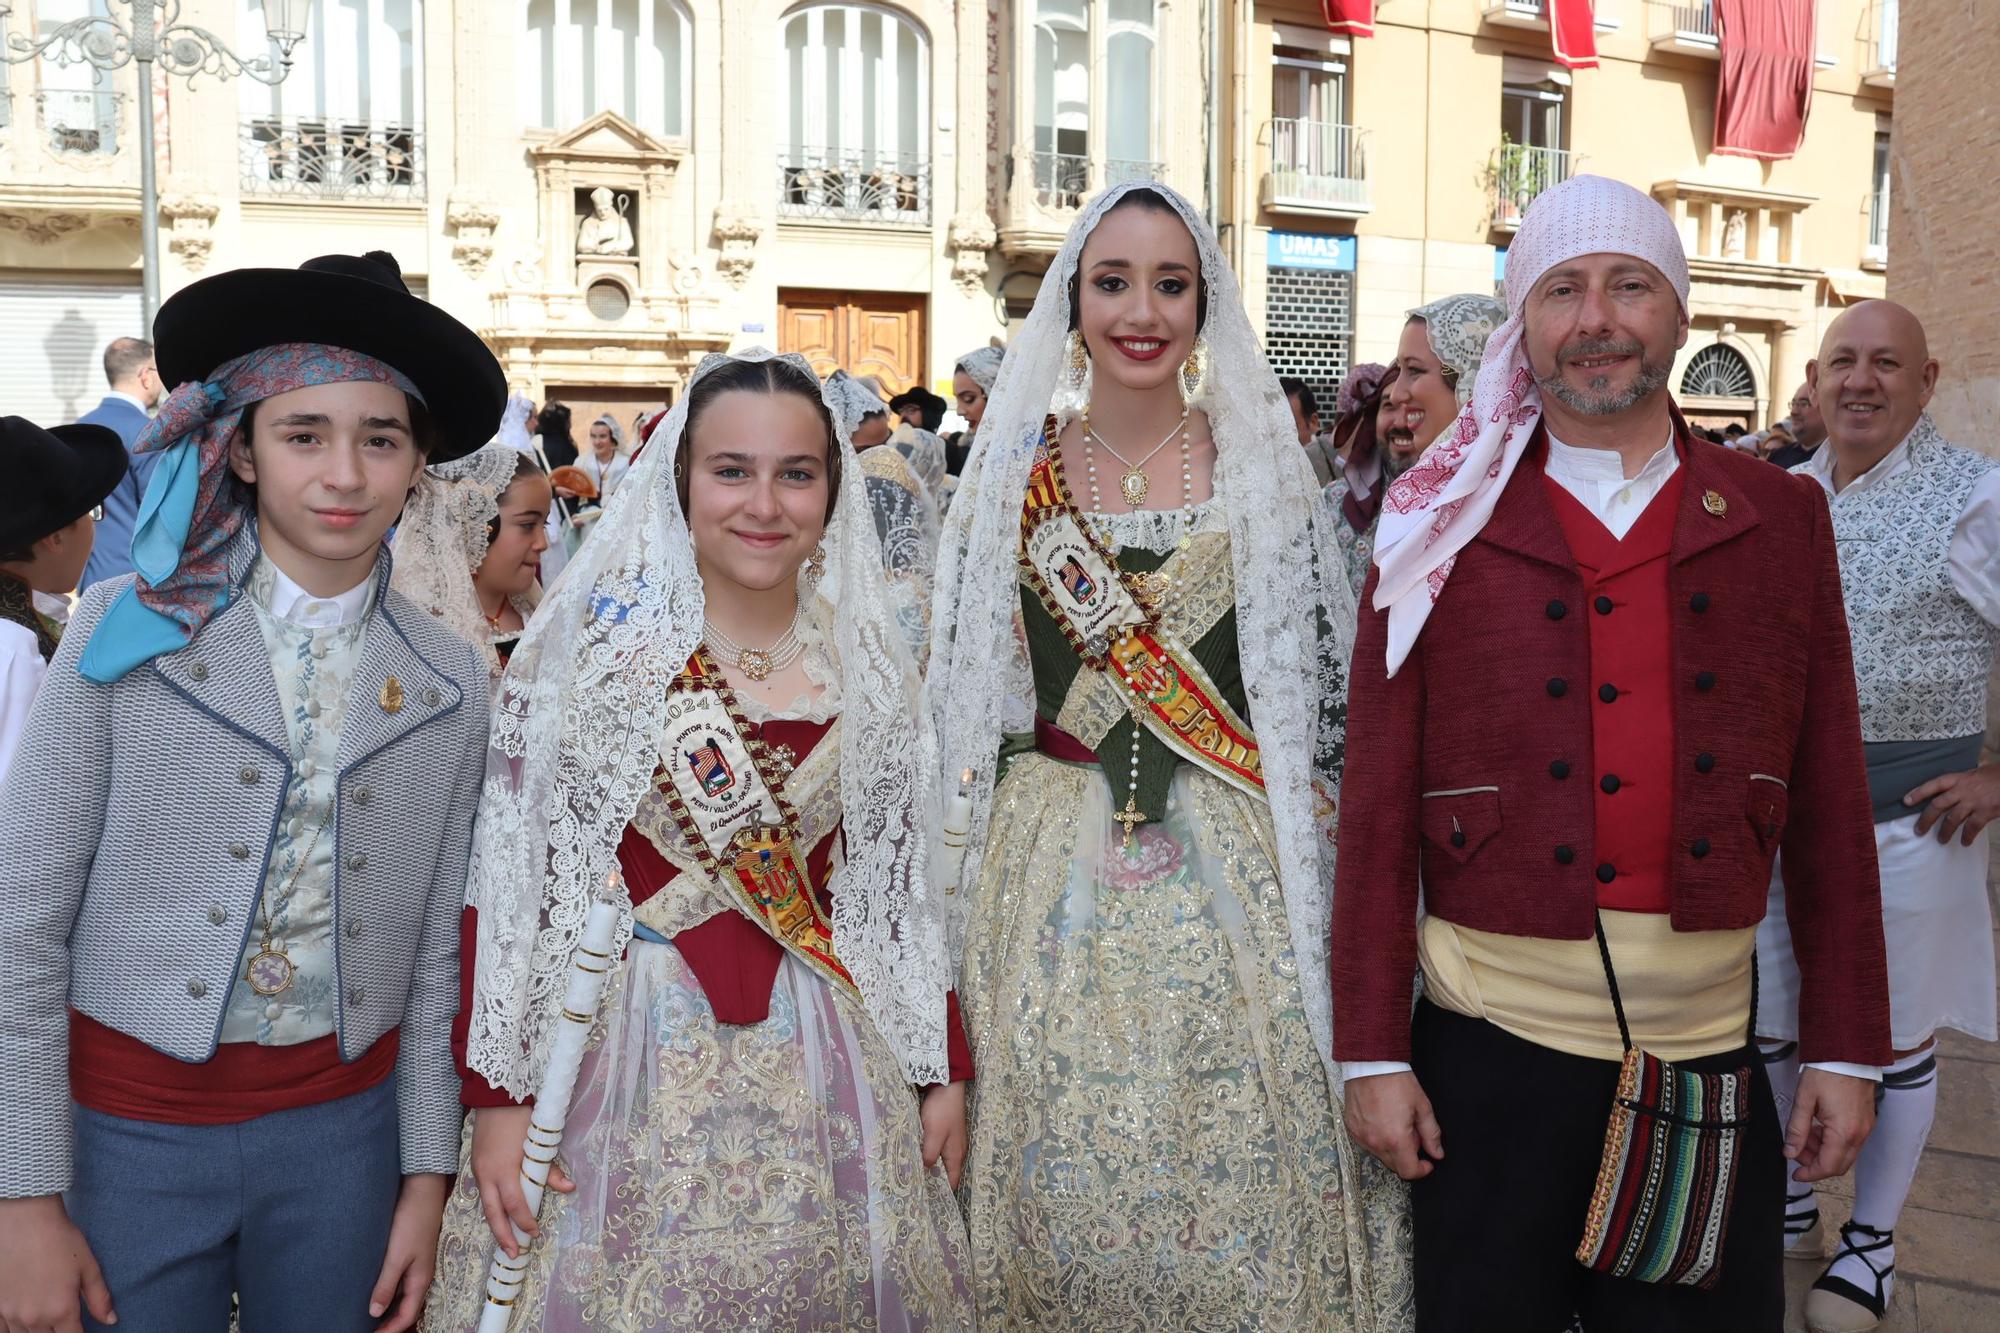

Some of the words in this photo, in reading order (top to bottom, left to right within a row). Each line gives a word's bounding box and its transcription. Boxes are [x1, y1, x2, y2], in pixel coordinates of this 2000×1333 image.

[1280, 234, 1341, 258] UMAS
[1031, 521, 1063, 556] 2024
[1047, 544, 1063, 564] PINTOR
[1071, 543, 1087, 557] ABRIL
[1067, 606, 1081, 618] PERIS
[670, 746, 680, 772] FALLA
[676, 723, 703, 744] PINTOR
[705, 723, 713, 731] S.
[715, 725, 736, 743] ABRIL
[690, 797, 709, 813] PERIS
[710, 822, 718, 832] El
